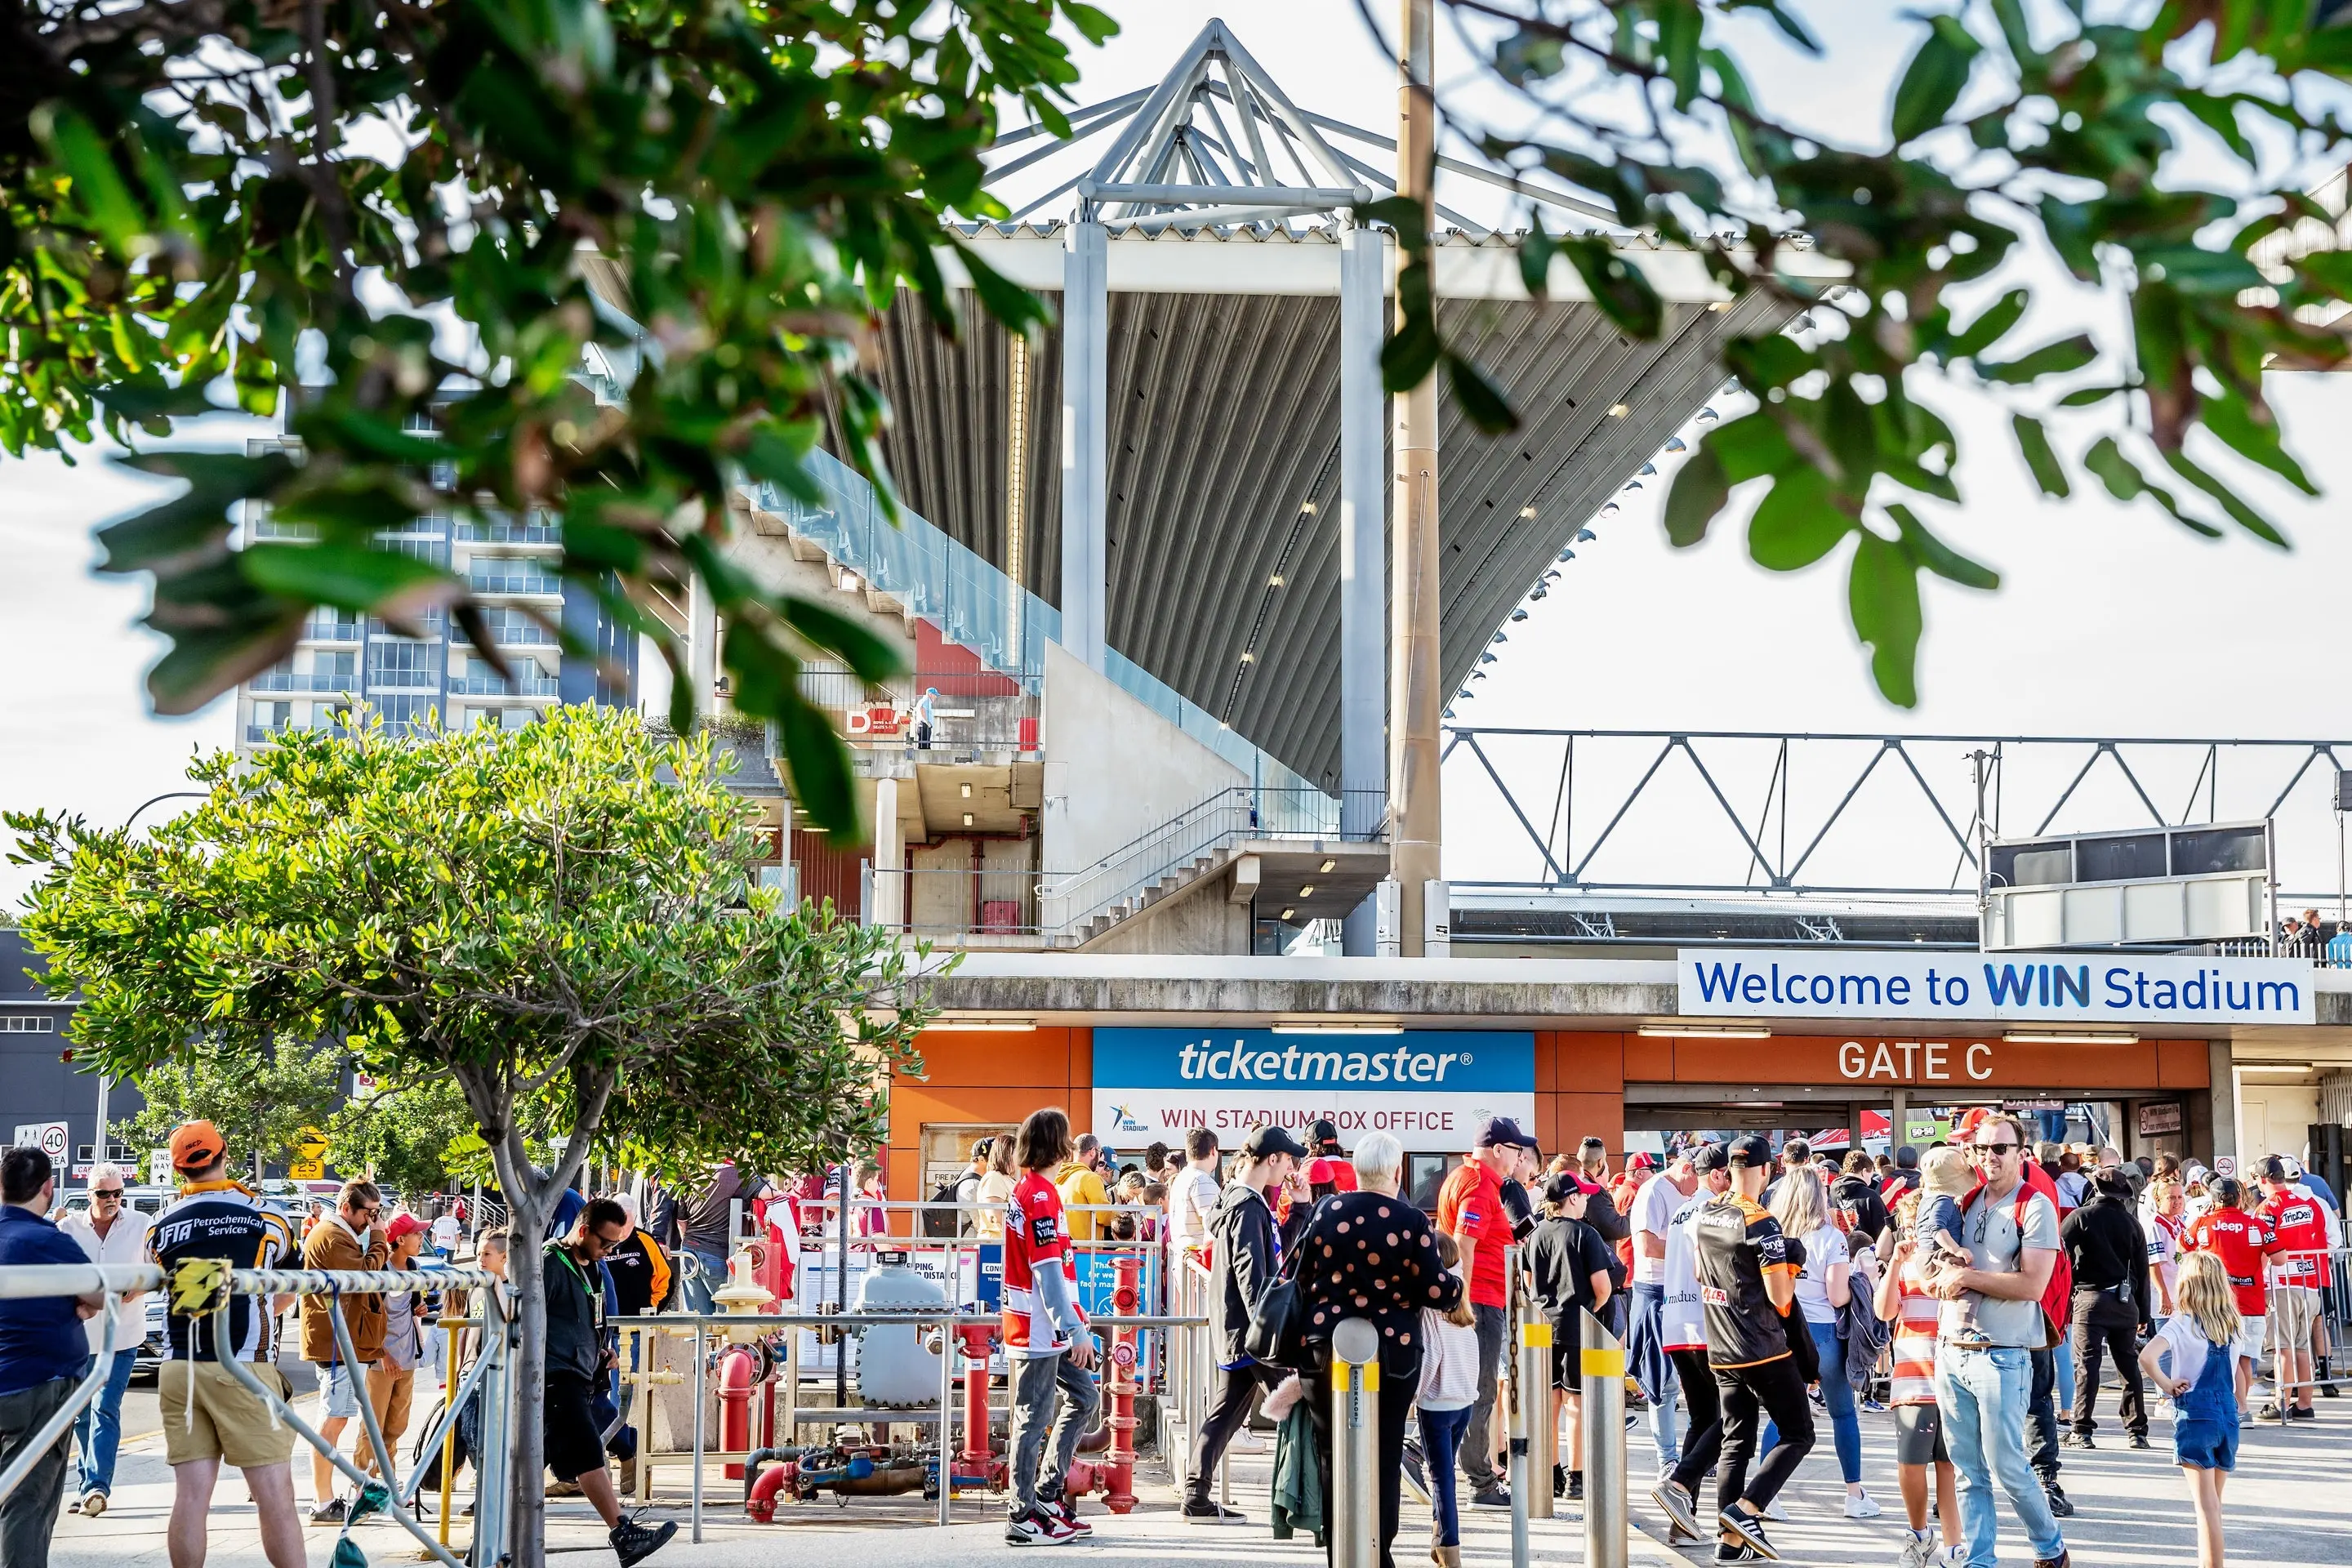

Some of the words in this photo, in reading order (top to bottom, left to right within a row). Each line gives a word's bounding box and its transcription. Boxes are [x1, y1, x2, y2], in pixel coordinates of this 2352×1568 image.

[1695, 961, 1911, 1006] Welcome
[1926, 969, 1970, 1006] to
[1983, 963, 2091, 1009] WIN
[2104, 967, 2301, 1012] Stadium
[1838, 1041, 1951, 1080] GATE
[1966, 1042, 1993, 1081] C
[1160, 1109, 1206, 1128] WIN
[1215, 1109, 1316, 1129] STADIUM
[1322, 1110, 1367, 1130] BOX
[1374, 1111, 1454, 1131] OFFICE
[44, 1133, 63, 1147] 40
[50, 1156, 66, 1165] REA
[297, 1160, 318, 1173] 25
[194, 1214, 265, 1229] Petrochemical
[2212, 1219, 2244, 1234] Jeep
[208, 1225, 248, 1236] Services
[924, 1272, 961, 1280] DISTAC
